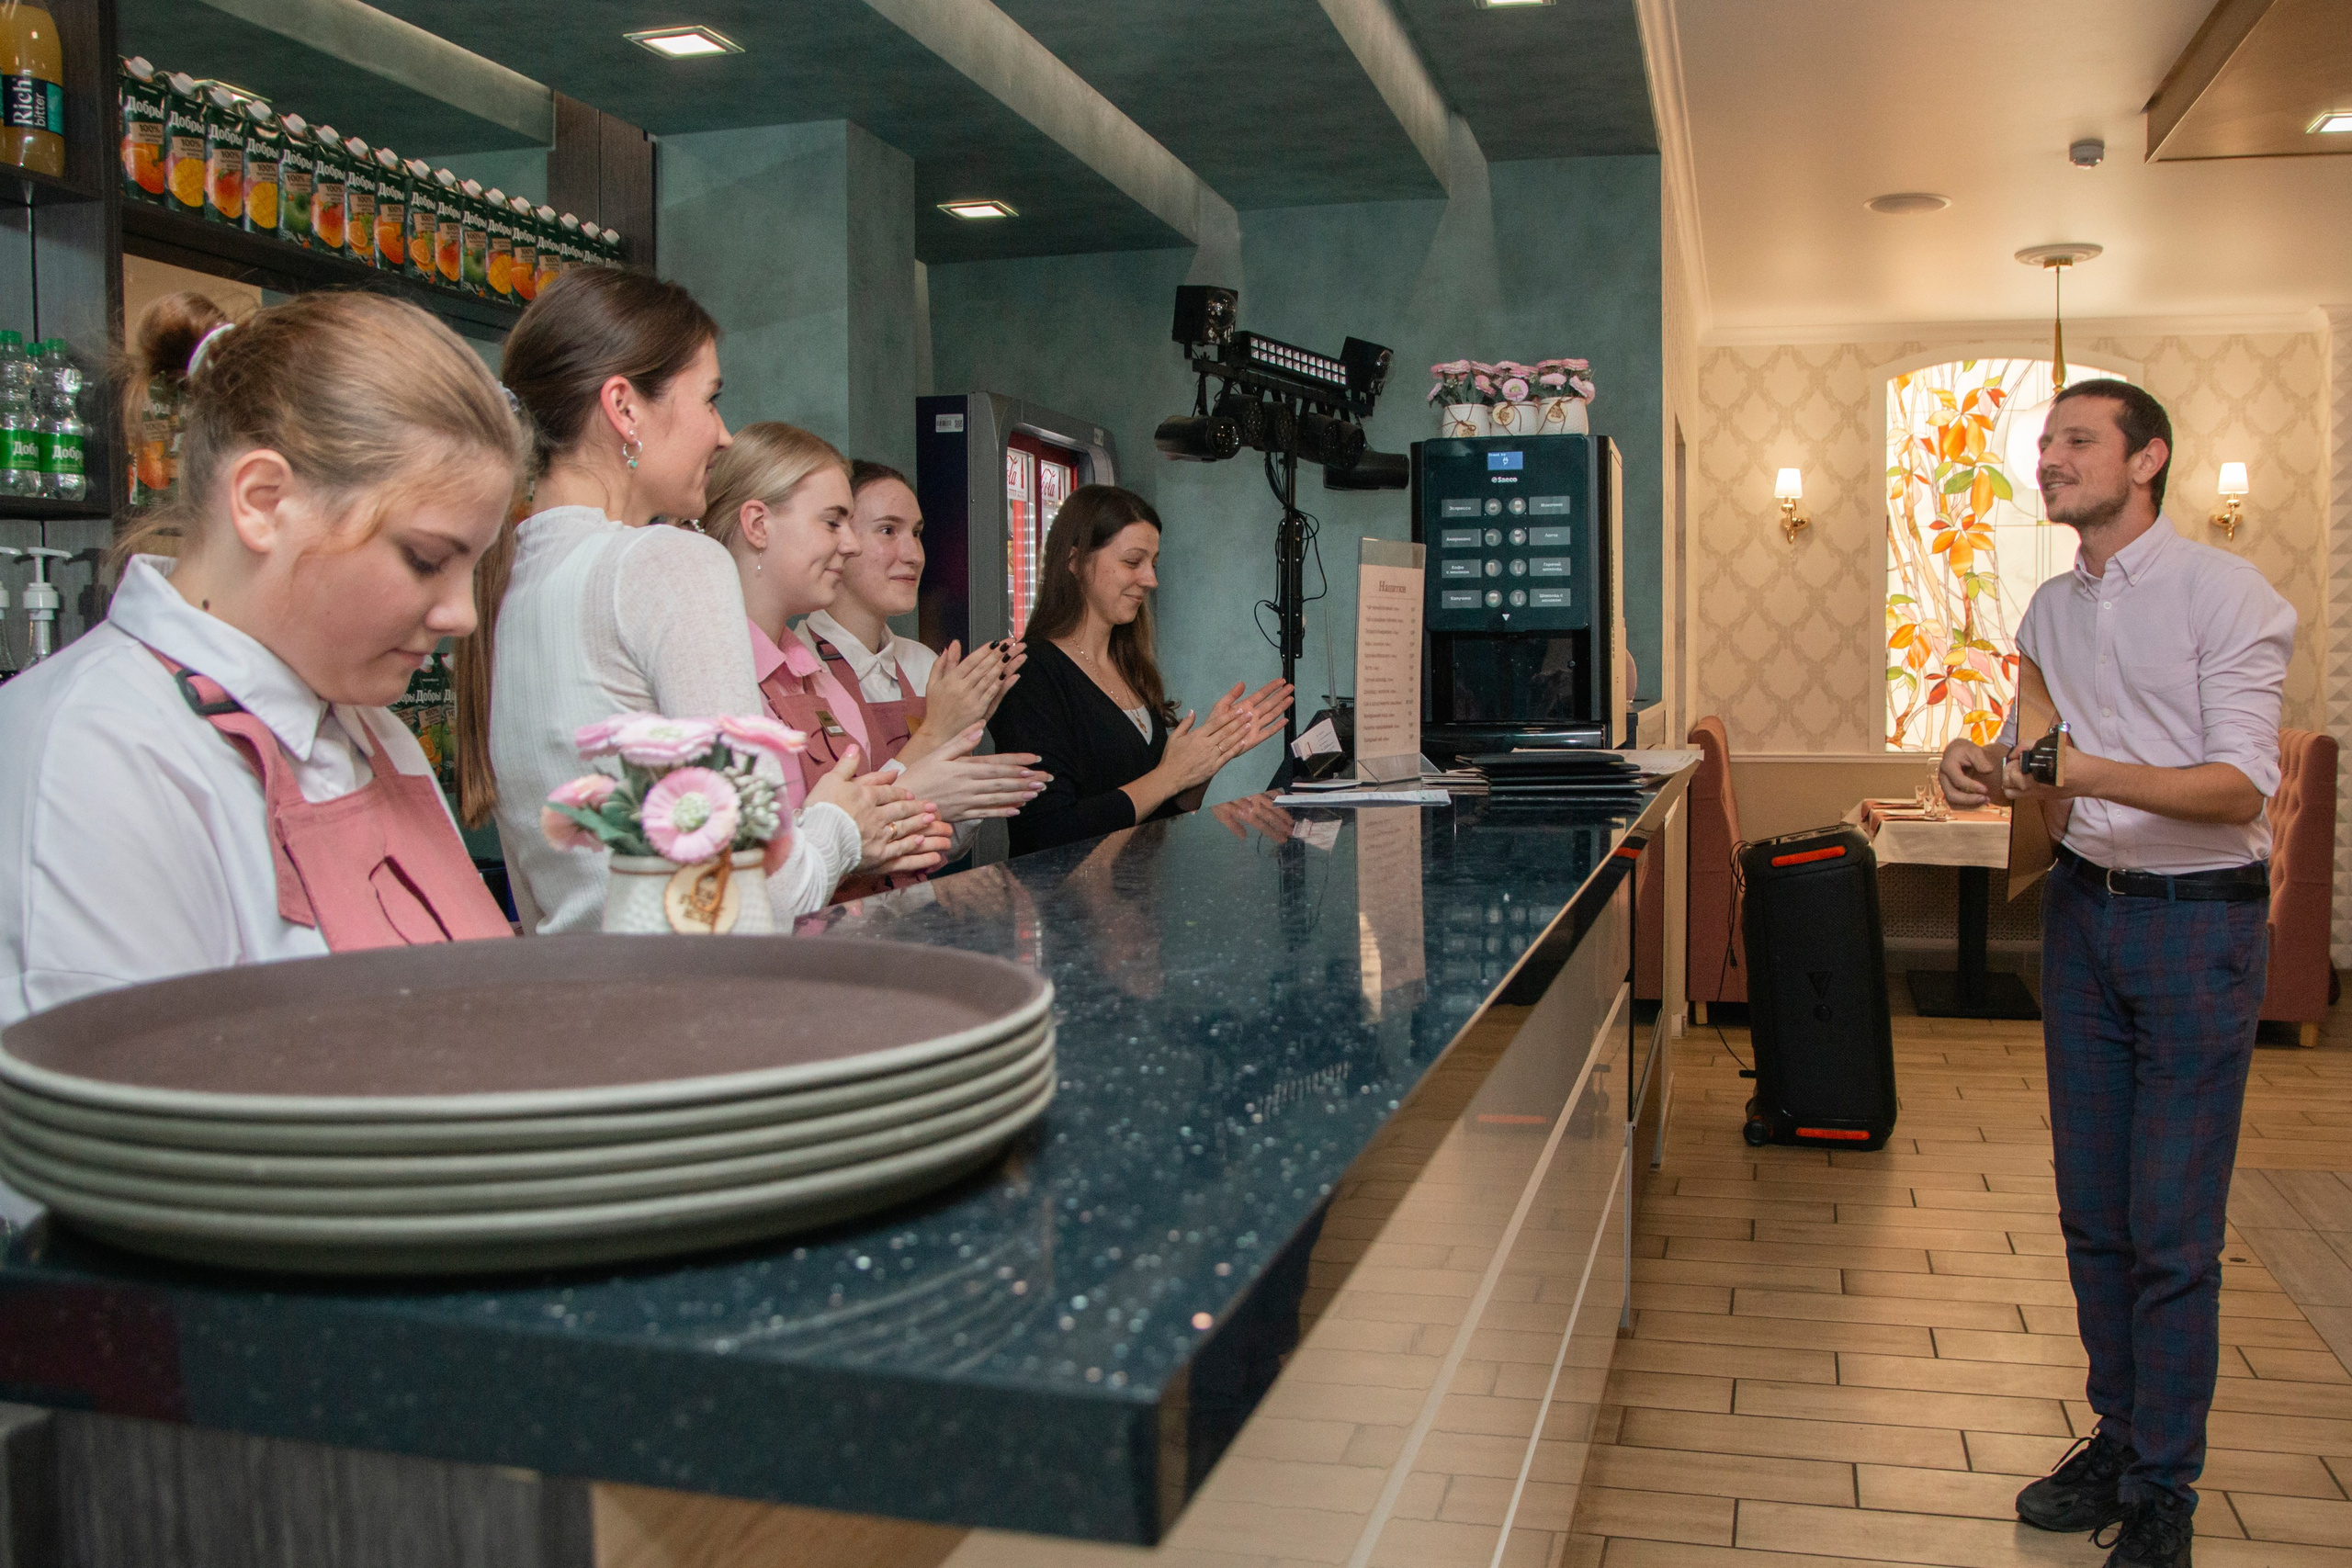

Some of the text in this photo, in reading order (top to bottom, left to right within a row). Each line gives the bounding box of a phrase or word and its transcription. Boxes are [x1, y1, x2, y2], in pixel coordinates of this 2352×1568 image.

[13, 80, 33, 125] Rich
[35, 93, 46, 127] bitter
[123, 96, 164, 119] Добры
[139, 124, 161, 132] 100%
[169, 111, 205, 135] Добры
[181, 139, 200, 147] 100%
[209, 124, 243, 146] Добры
[221, 151, 241, 159] 100%
[246, 138, 279, 159] Добры
[279, 149, 312, 170] Добры
[316, 160, 345, 180] Добры
[347, 172, 375, 191] Добры
[378, 182, 404, 200] Добры
[412, 192, 435, 210] Добры
[437, 202, 460, 220] Добры
[462, 210, 486, 229] Добры
[487, 220, 512, 236] Добры
[513, 227, 536, 243] Добры
[1378, 580, 1407, 593] Напитки
[416, 690, 441, 703] Добры
